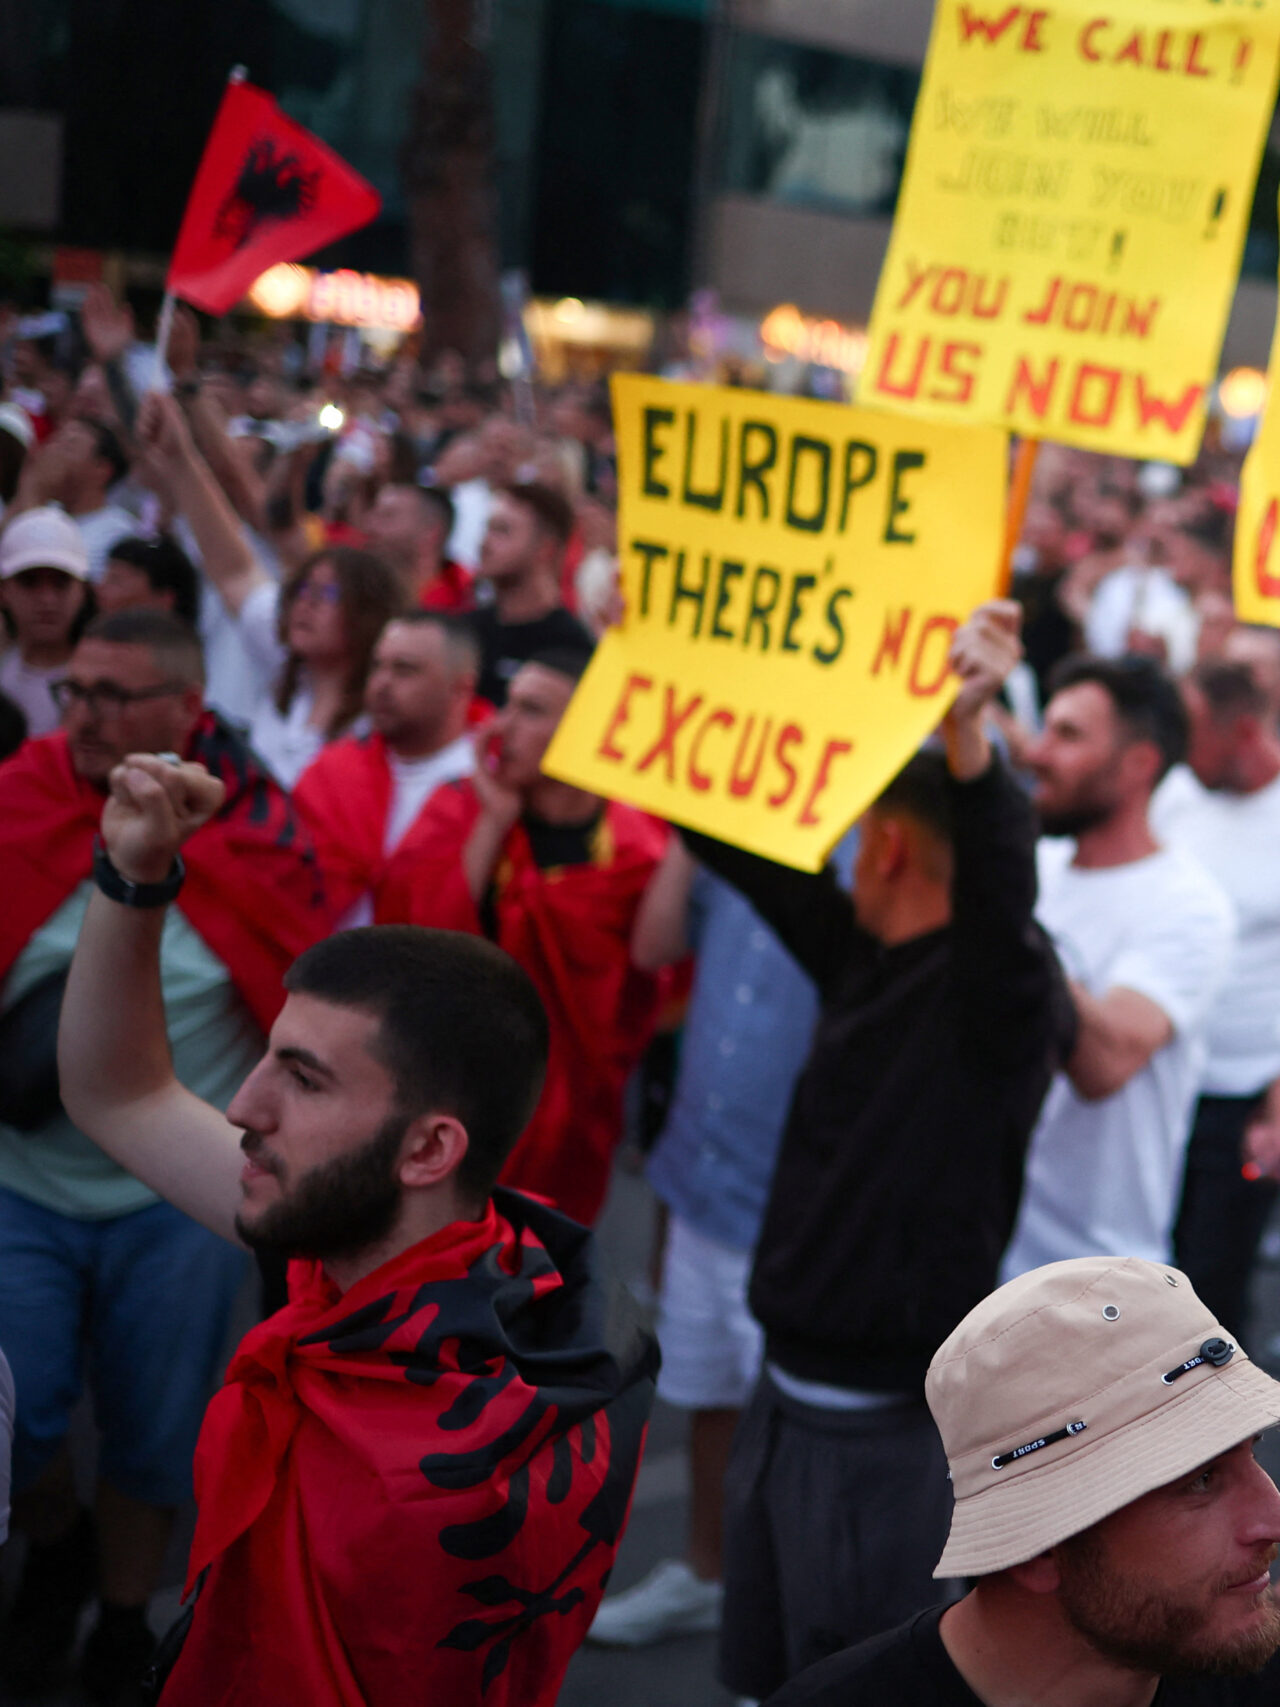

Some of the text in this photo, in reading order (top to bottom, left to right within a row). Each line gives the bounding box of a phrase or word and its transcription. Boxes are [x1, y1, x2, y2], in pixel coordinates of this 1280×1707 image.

[958, 5, 1048, 53] WE
[1035, 101, 1155, 148] WILL
[934, 145, 1073, 201] JOIN
[896, 257, 1162, 340] YOU JOIN
[874, 331, 984, 405] US
[1004, 353, 1206, 435] NOW
[640, 405, 926, 546] EUROPE
[631, 538, 958, 698] THERE'S NO
[595, 671, 855, 828] EXCUSE
[1012, 1438, 1046, 1459] SPORT
